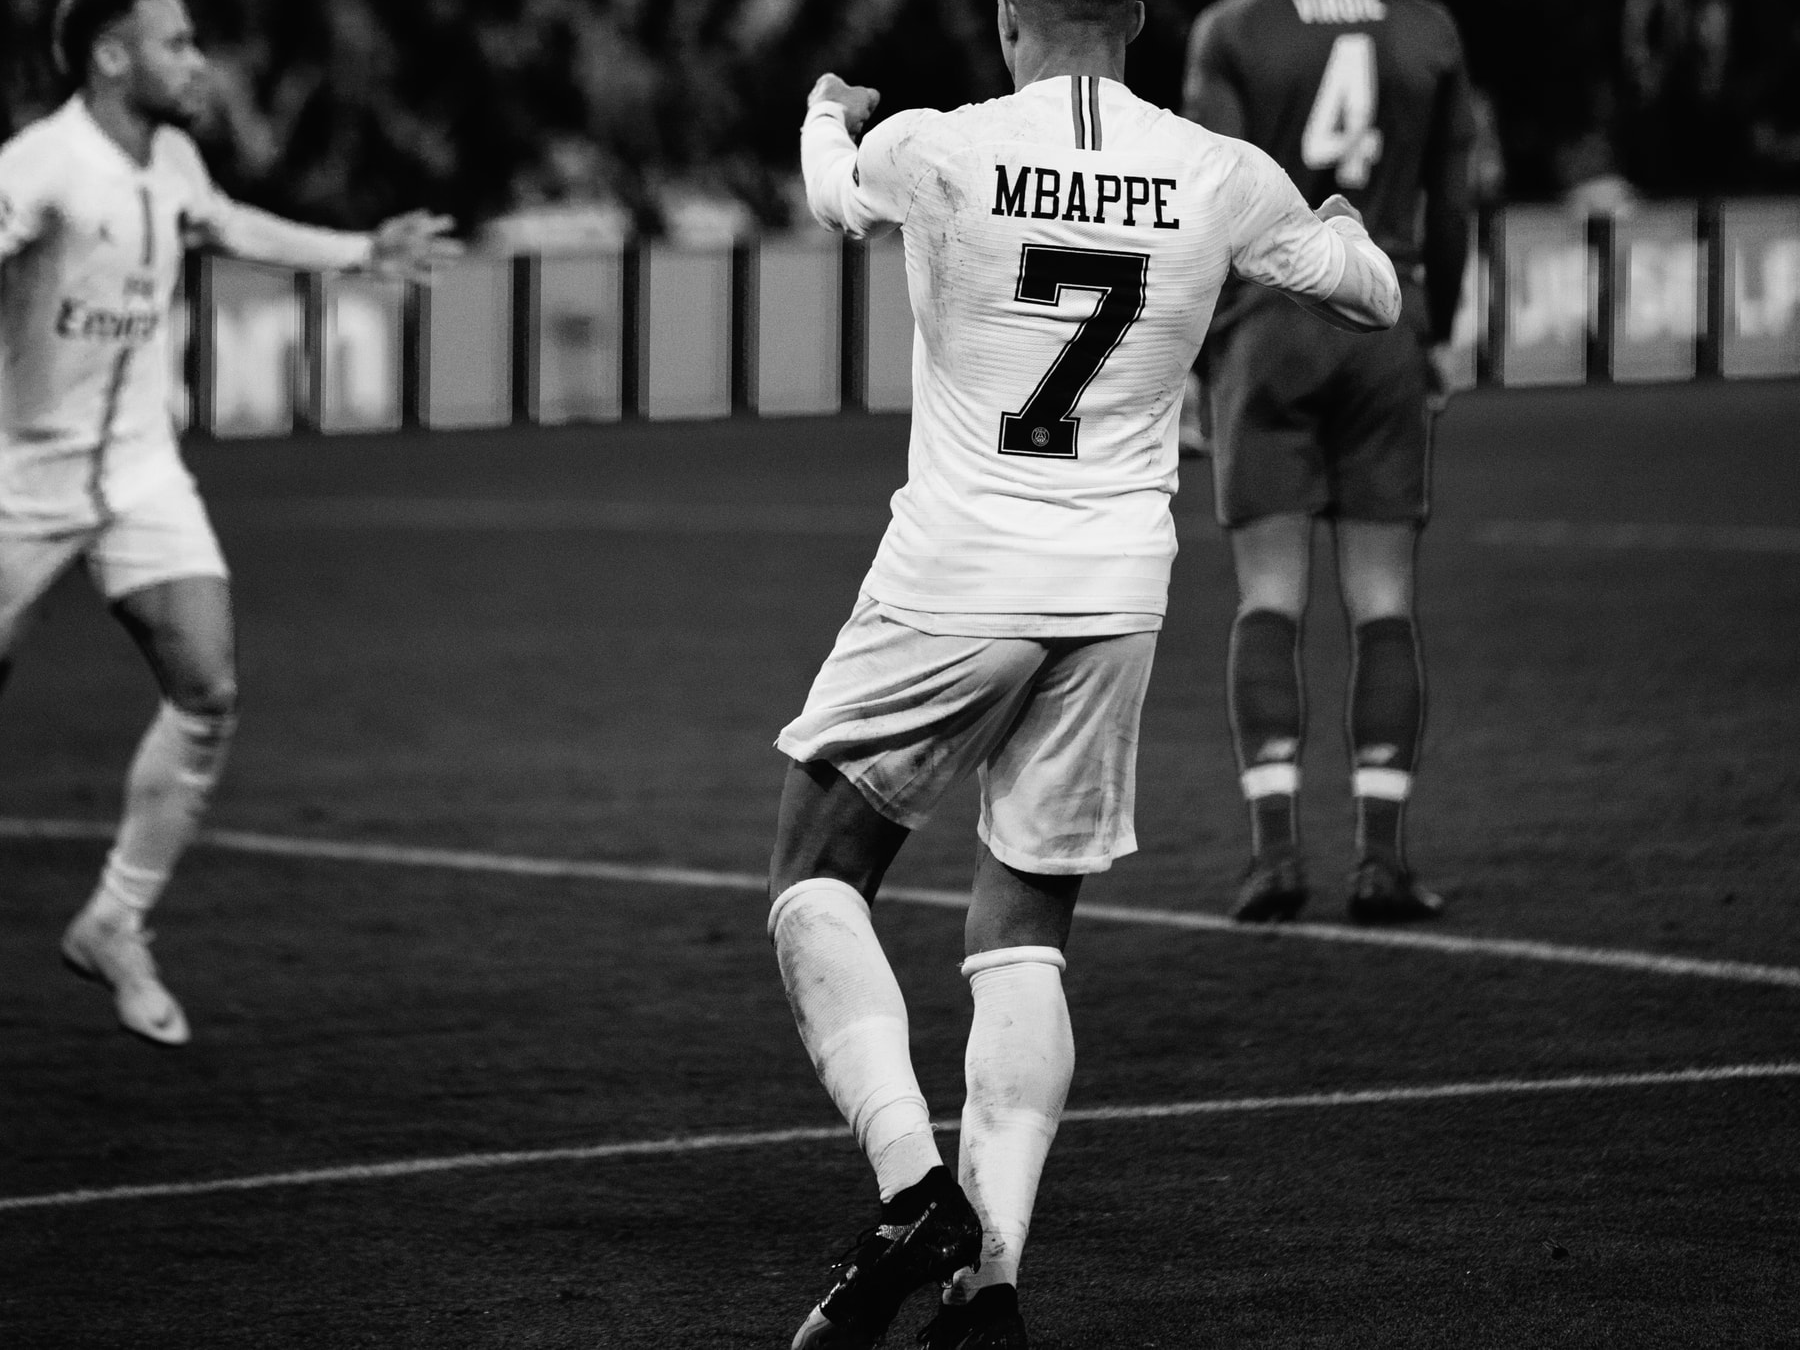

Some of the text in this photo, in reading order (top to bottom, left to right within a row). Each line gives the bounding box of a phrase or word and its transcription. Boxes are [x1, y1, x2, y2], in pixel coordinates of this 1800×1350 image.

[1302, 32, 1384, 189] 4
[991, 164, 1180, 230] MBAPPE
[998, 243, 1151, 460] 7
